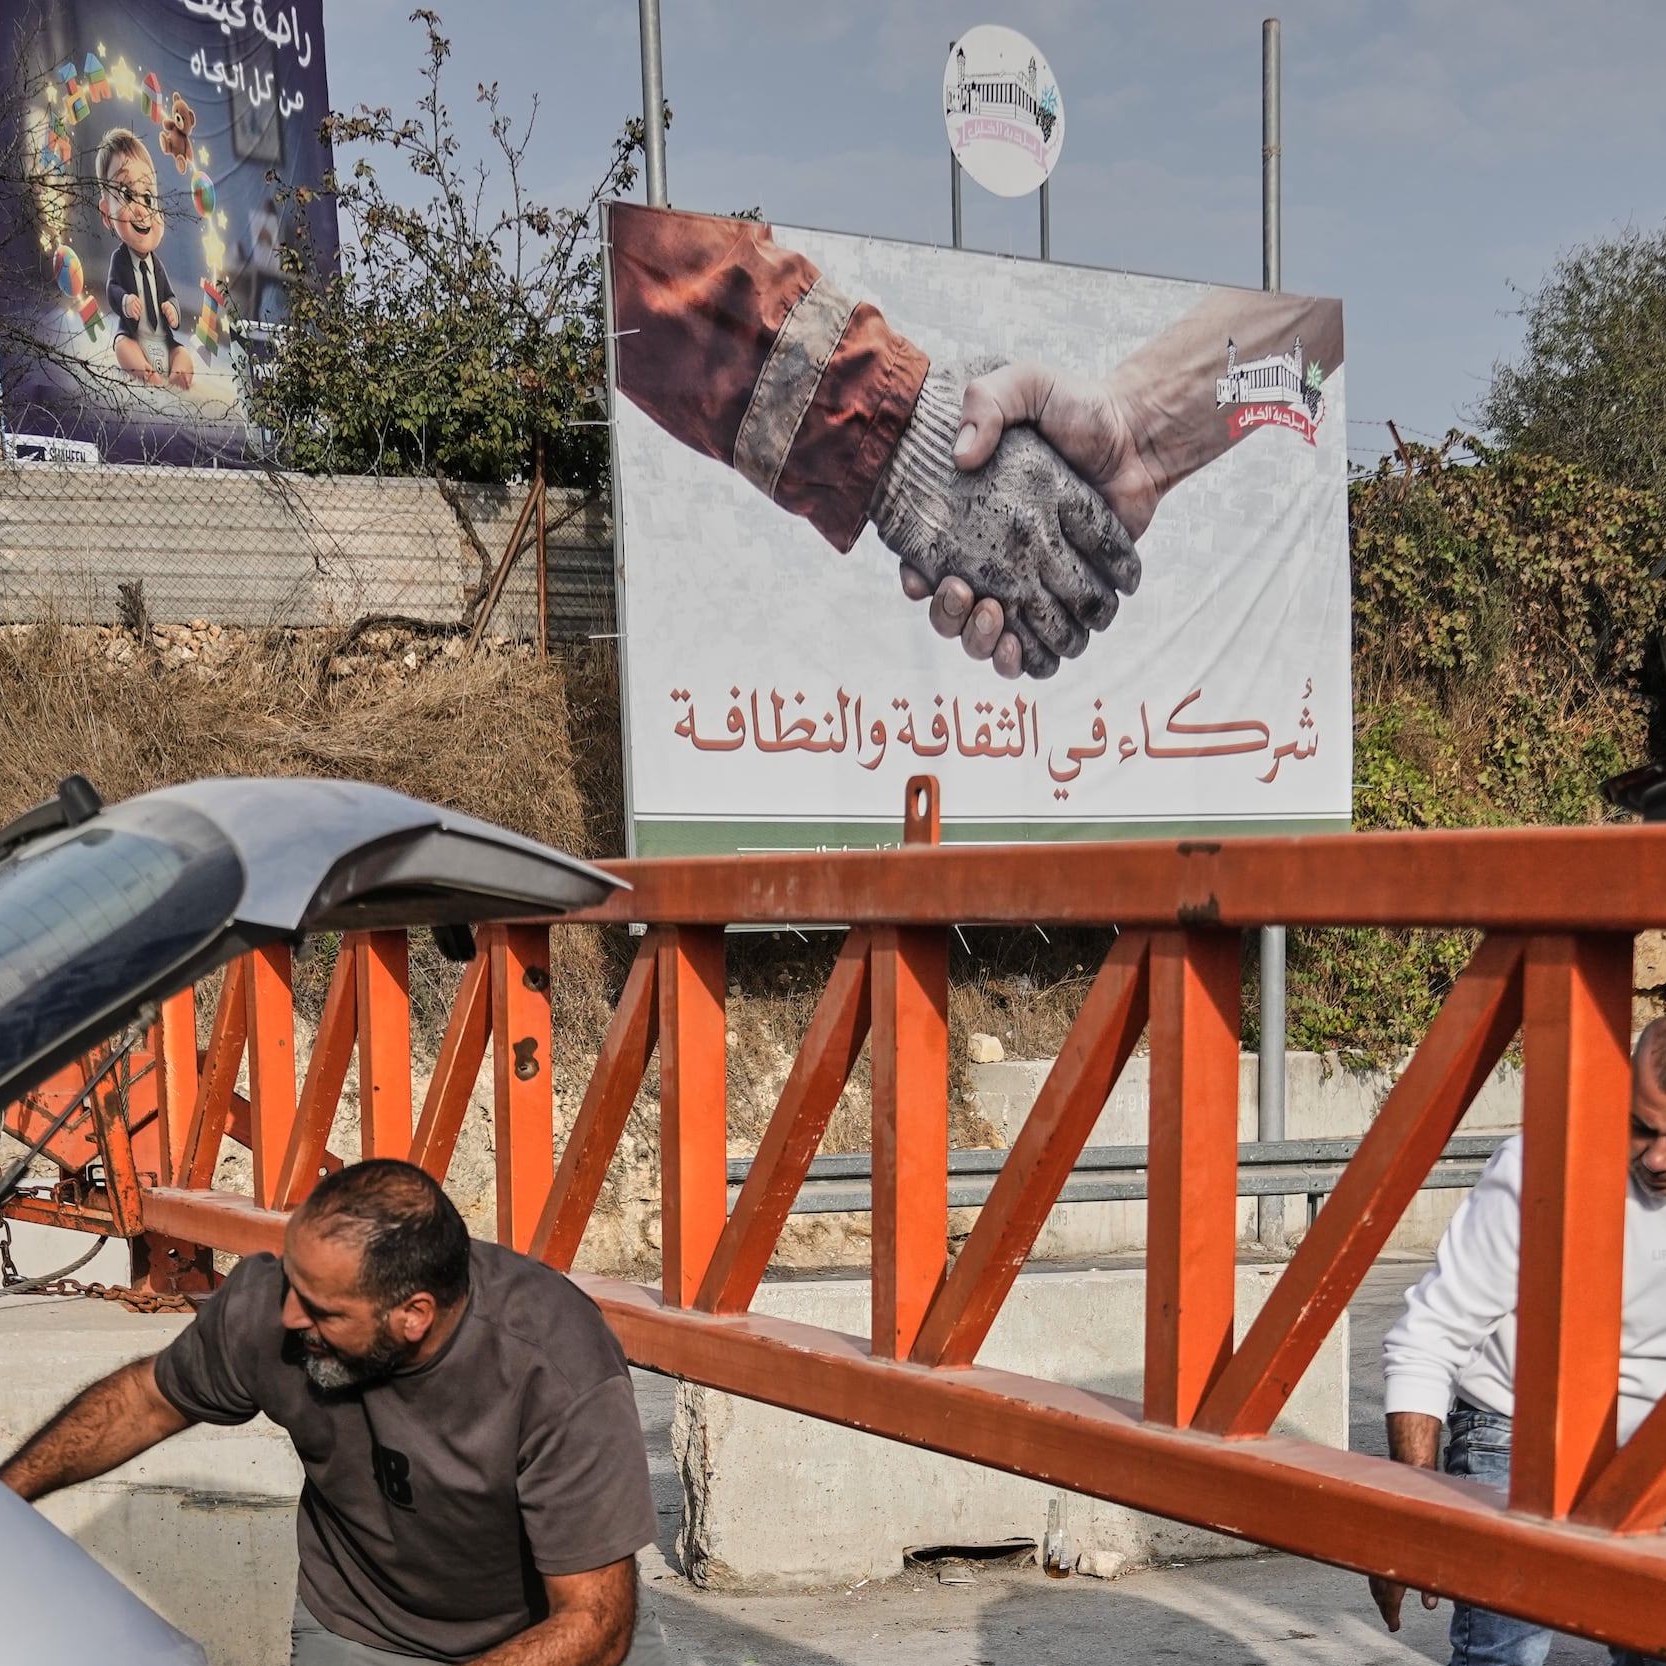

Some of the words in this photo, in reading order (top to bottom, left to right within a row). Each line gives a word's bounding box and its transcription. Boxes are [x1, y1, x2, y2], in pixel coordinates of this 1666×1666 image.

[253, 0, 312, 67] راحة
[190, 48, 245, 93] اتجاه
[249, 67, 274, 107] كل
[279, 88, 304, 118] من
[967, 120, 1003, 138] الخليل
[1004, 122, 1037, 149] بلدية
[1238, 405, 1272, 427] الخليل
[1273, 406, 1306, 431] بلدية
[670, 686, 888, 770] والنظافة
[891, 692, 1039, 758] الثقافة
[1047, 698, 1108, 801] في
